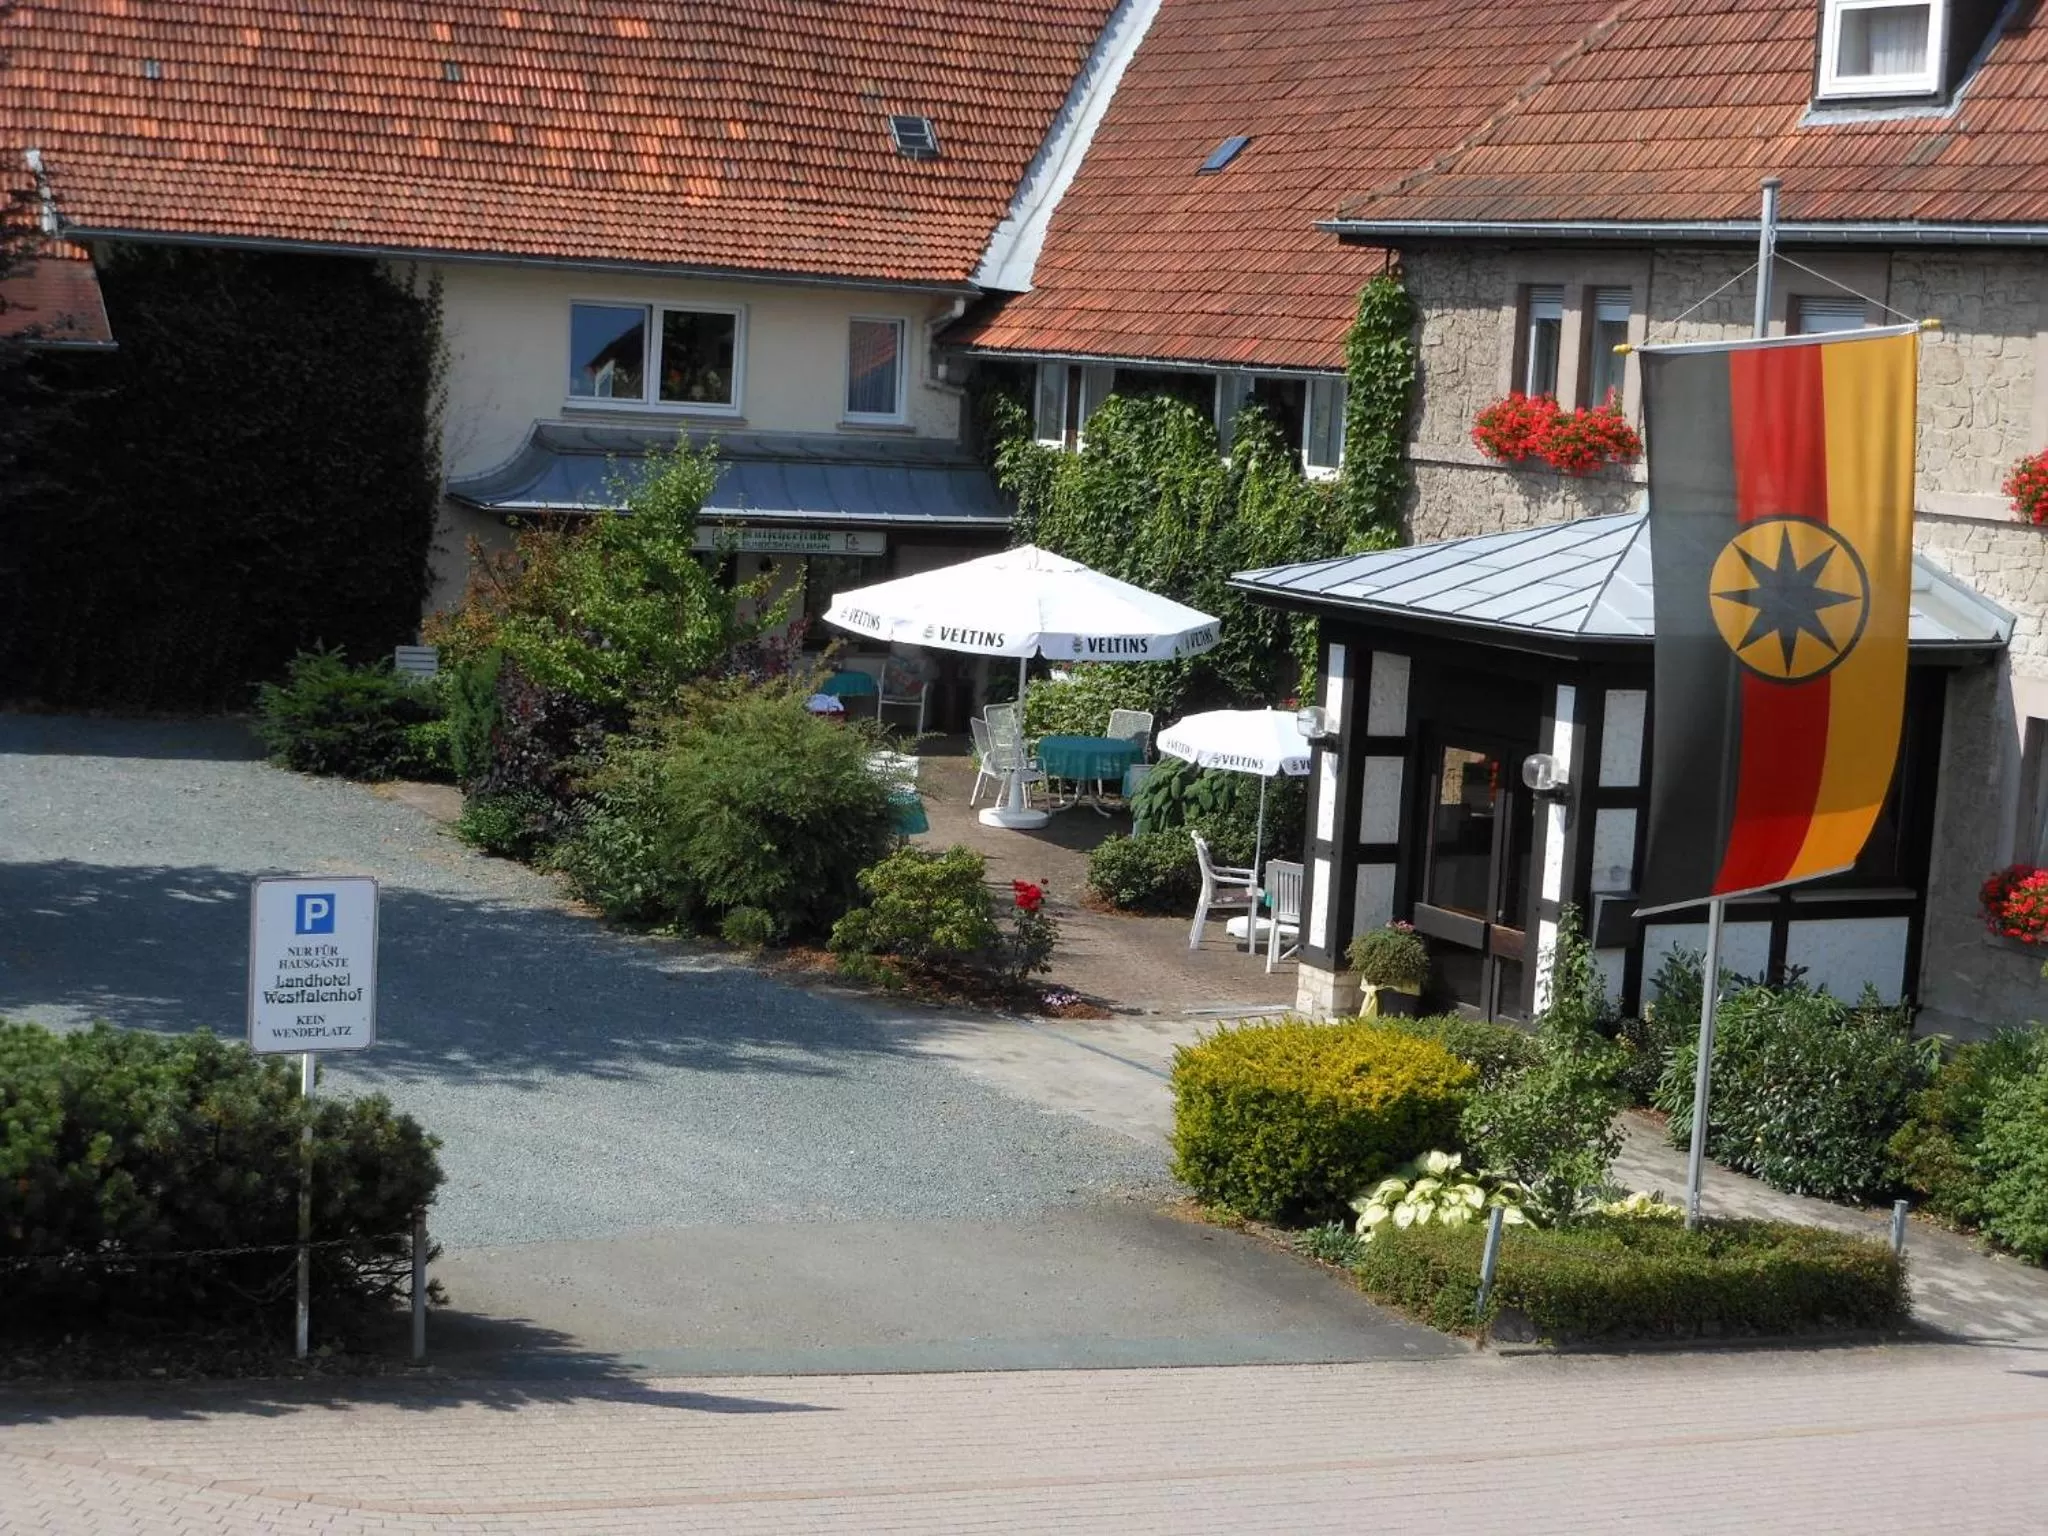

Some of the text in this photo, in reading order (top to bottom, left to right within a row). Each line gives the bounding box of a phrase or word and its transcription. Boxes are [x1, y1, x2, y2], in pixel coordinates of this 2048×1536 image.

[849, 608, 881, 632] VELTINS
[939, 626, 1006, 648] VELTINS
[1087, 637, 1148, 654] VELTINS
[1222, 754, 1264, 770] VELTINS
[304, 897, 329, 931] P
[287, 945, 339, 957] NUR FÜR
[279, 957, 349, 969] HAUSGÄSTE
[276, 974, 351, 988] Landhotel
[264, 988, 363, 1004] Westfalenhof
[296, 1015, 326, 1025] KEIN
[272, 1026, 352, 1038] WENDEPLATZ
